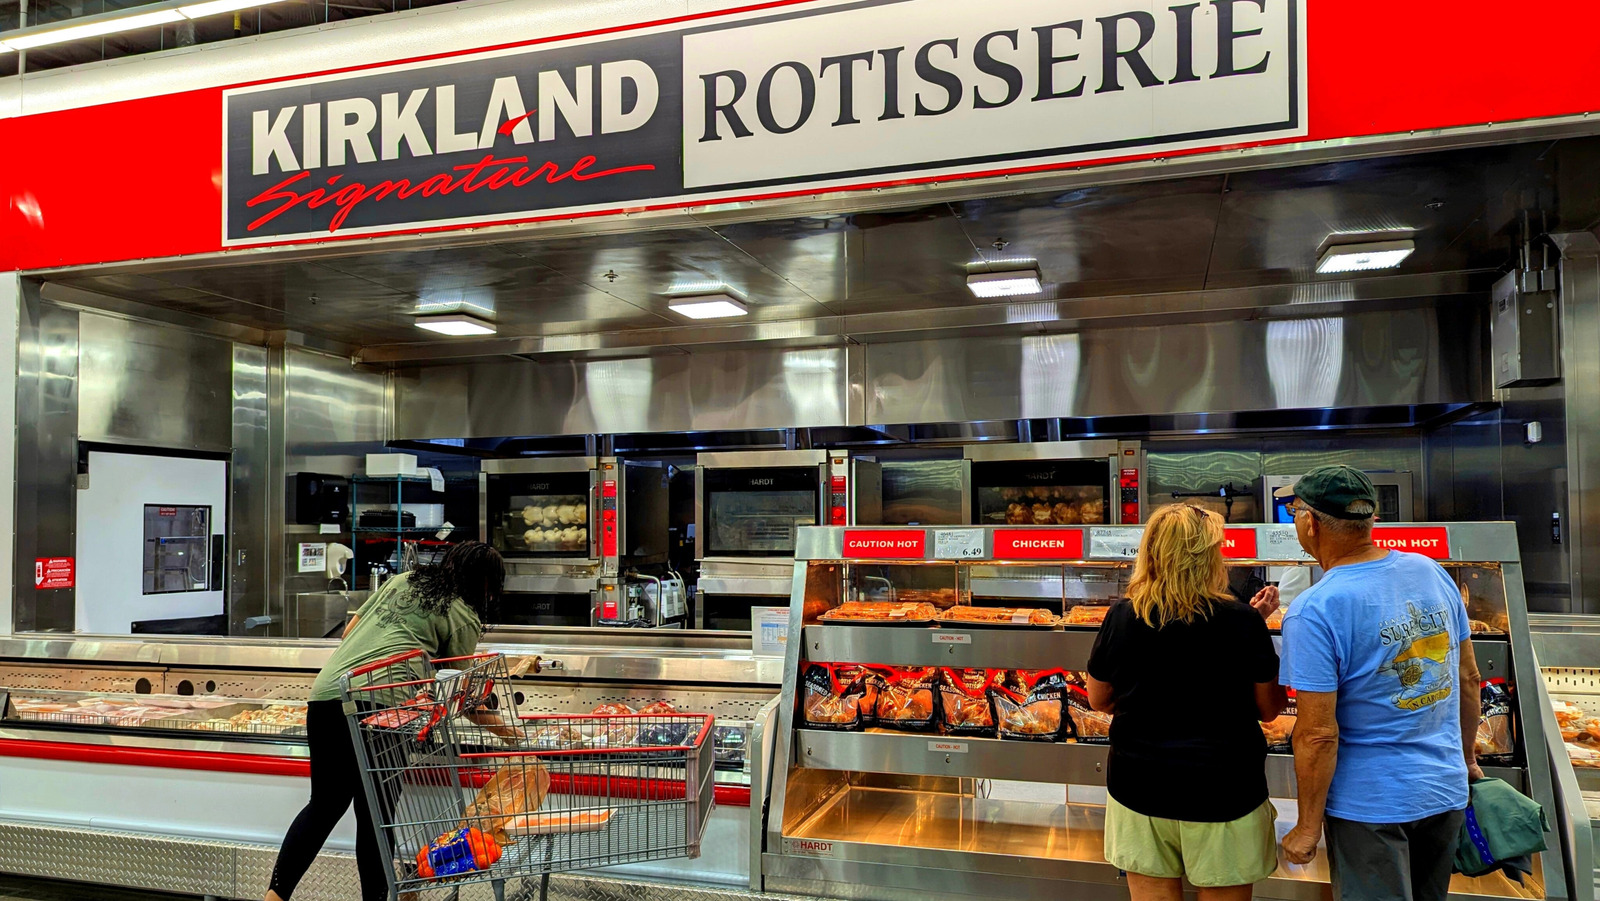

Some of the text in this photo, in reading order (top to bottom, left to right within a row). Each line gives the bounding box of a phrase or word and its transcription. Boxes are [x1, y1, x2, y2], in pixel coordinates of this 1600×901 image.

[698, 0, 1272, 143] ROTISSERIE
[252, 59, 659, 175] KIRKLAND
[246, 154, 656, 233] Signature
[849, 540, 918, 548] CAUTION HOT
[1012, 540, 1065, 548] CHICKEN
[1374, 539, 1439, 547] TION HOT
[962, 547, 982, 556] 6.49
[800, 841, 833, 851] HARDT
